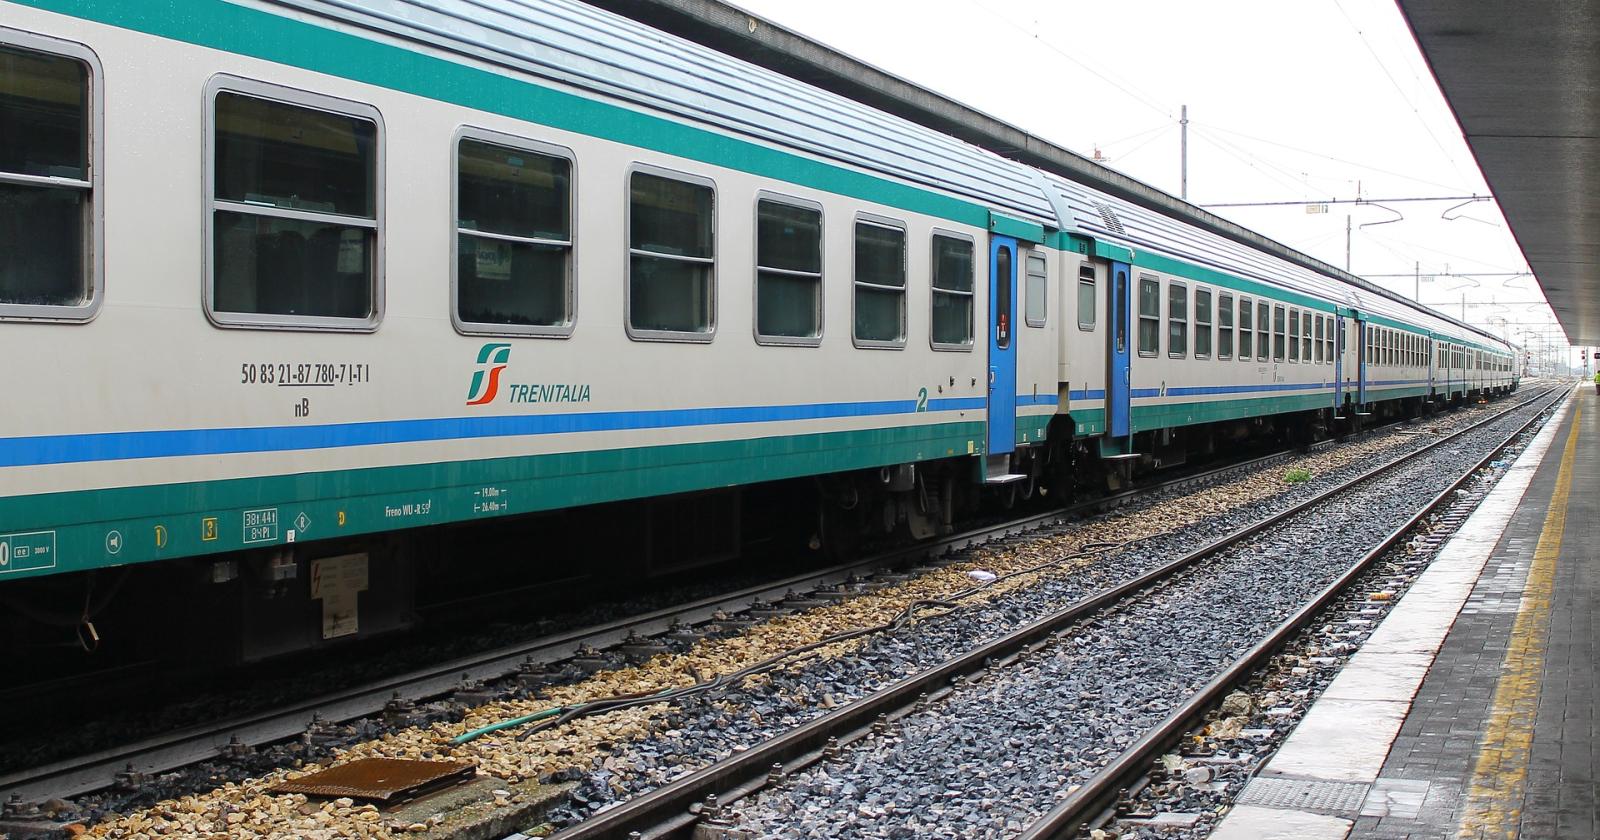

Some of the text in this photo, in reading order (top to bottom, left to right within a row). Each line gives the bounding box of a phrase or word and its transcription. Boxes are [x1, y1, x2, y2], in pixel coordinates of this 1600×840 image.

[241, 363, 257, 384] 50
[260, 363, 275, 384] 83
[509, 384, 591, 403] TRENITALIA
[916, 387, 928, 412] 2
[294, 397, 310, 417] nB
[385, 505, 402, 518] Freno
[402, 504, 413, 516] WU
[207, 520, 213, 538] 3
